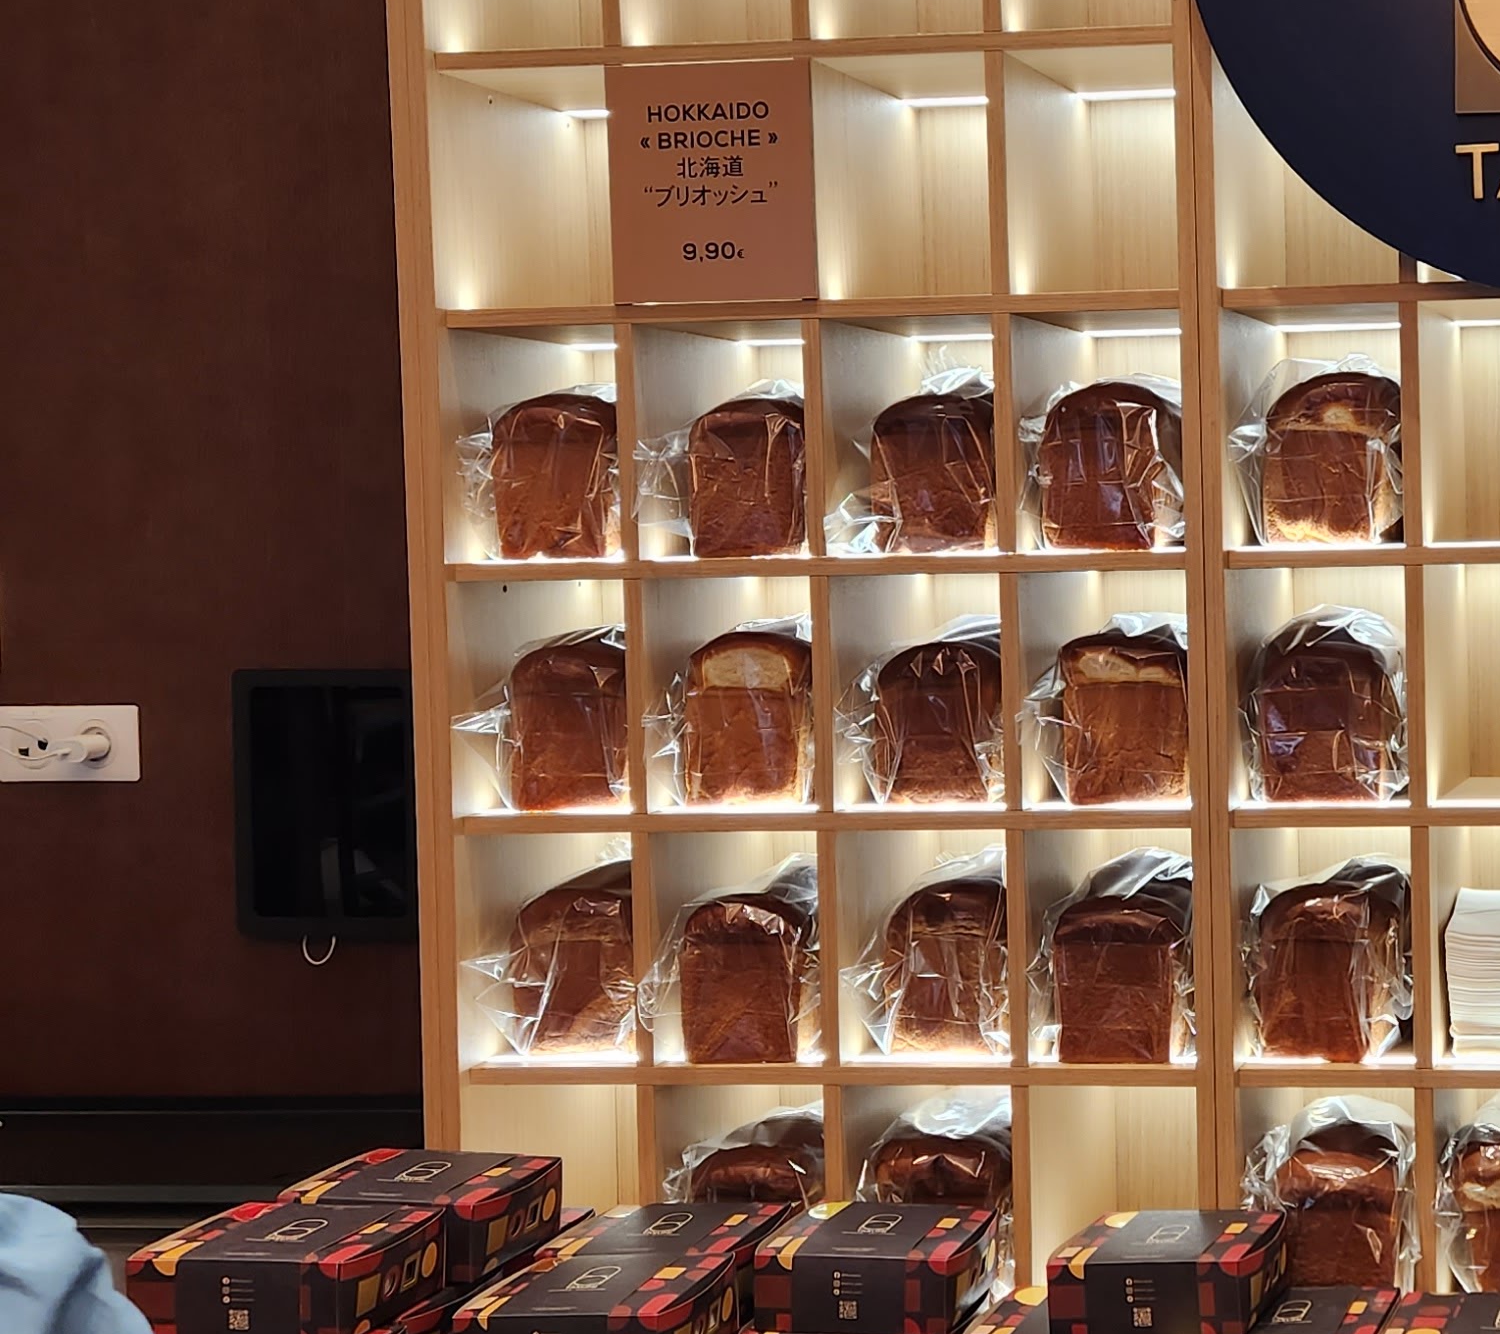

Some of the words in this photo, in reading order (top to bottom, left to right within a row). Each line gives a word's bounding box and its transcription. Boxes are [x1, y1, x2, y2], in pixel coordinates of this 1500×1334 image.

[647, 100, 769, 123] HOKKAIDO
[657, 129, 761, 150] BRIOCHE
[676, 155, 744, 179] 北海道
[682, 241, 745, 263] 9,90€
